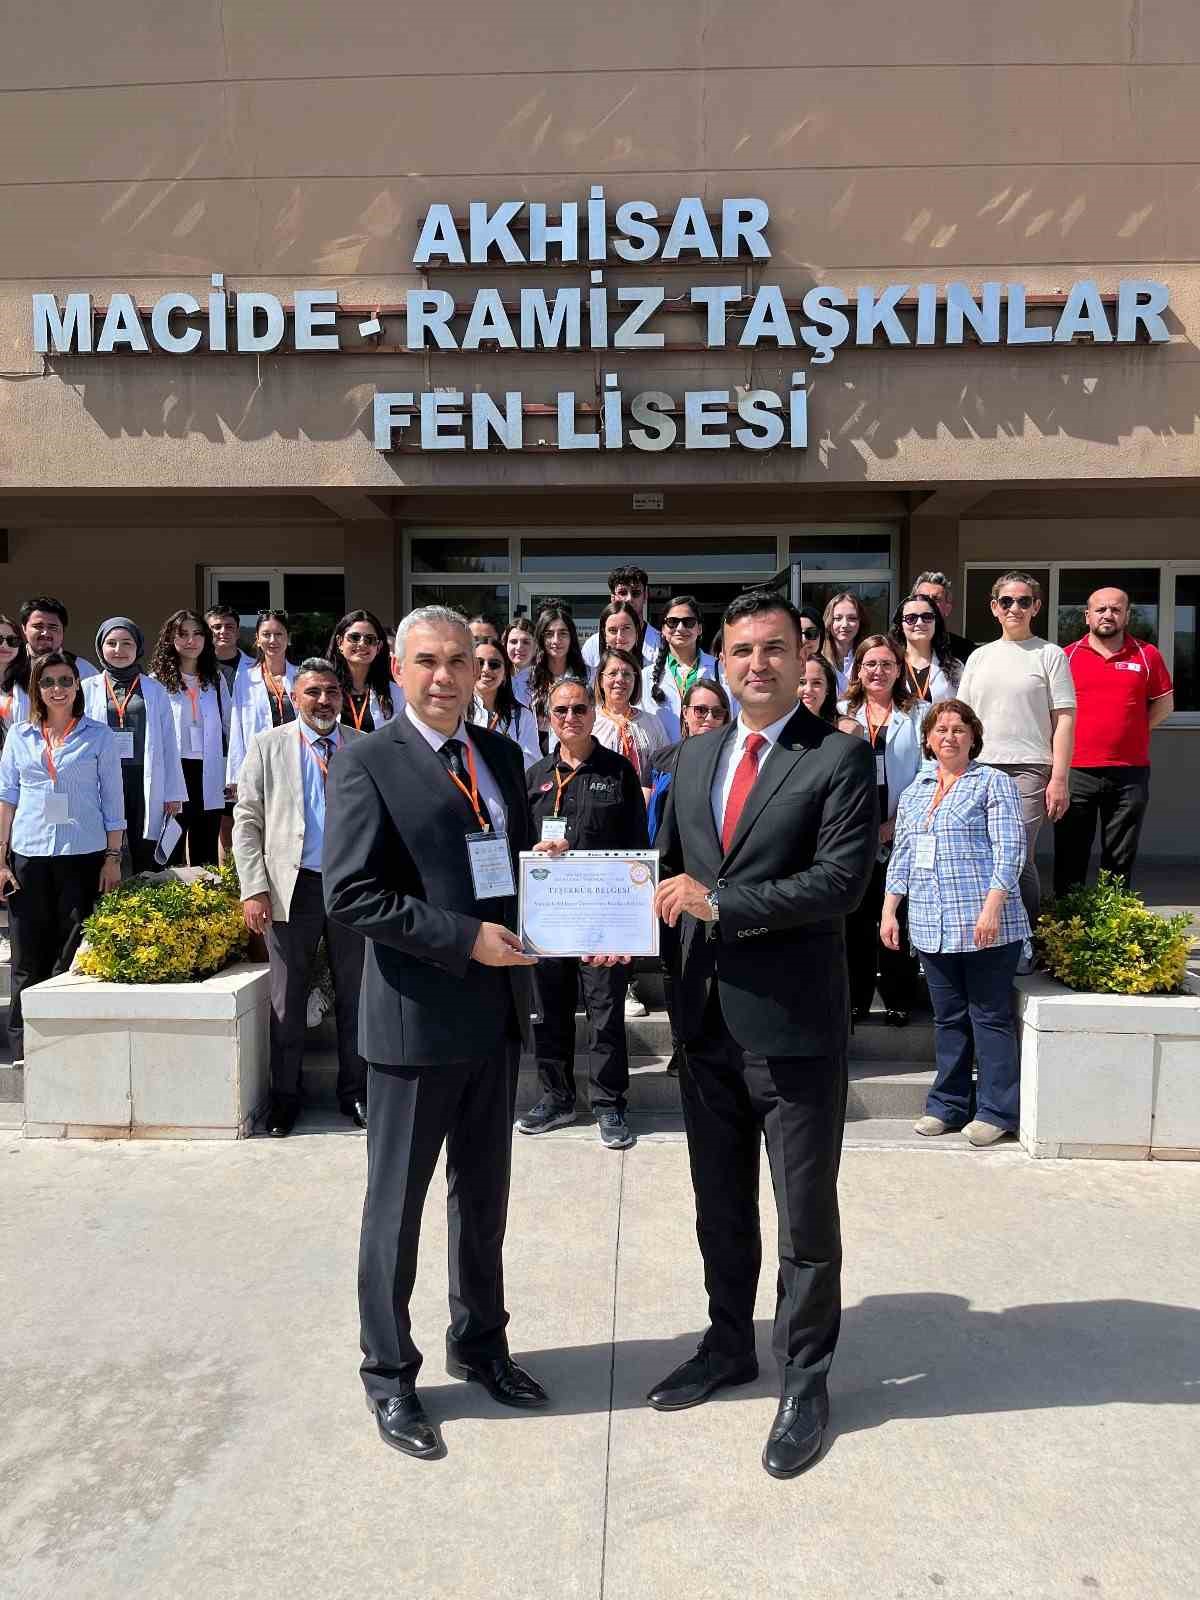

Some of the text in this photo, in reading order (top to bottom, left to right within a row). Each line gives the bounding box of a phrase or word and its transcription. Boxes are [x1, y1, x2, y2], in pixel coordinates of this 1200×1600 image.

[413, 185, 771, 265] AKHİSAR
[32, 273, 340, 354] MACİDE
[406, 270, 665, 352] RAMİZ
[691, 279, 1170, 364] TAŞKINLAR
[373, 372, 808, 452] FEN LİSESİ
